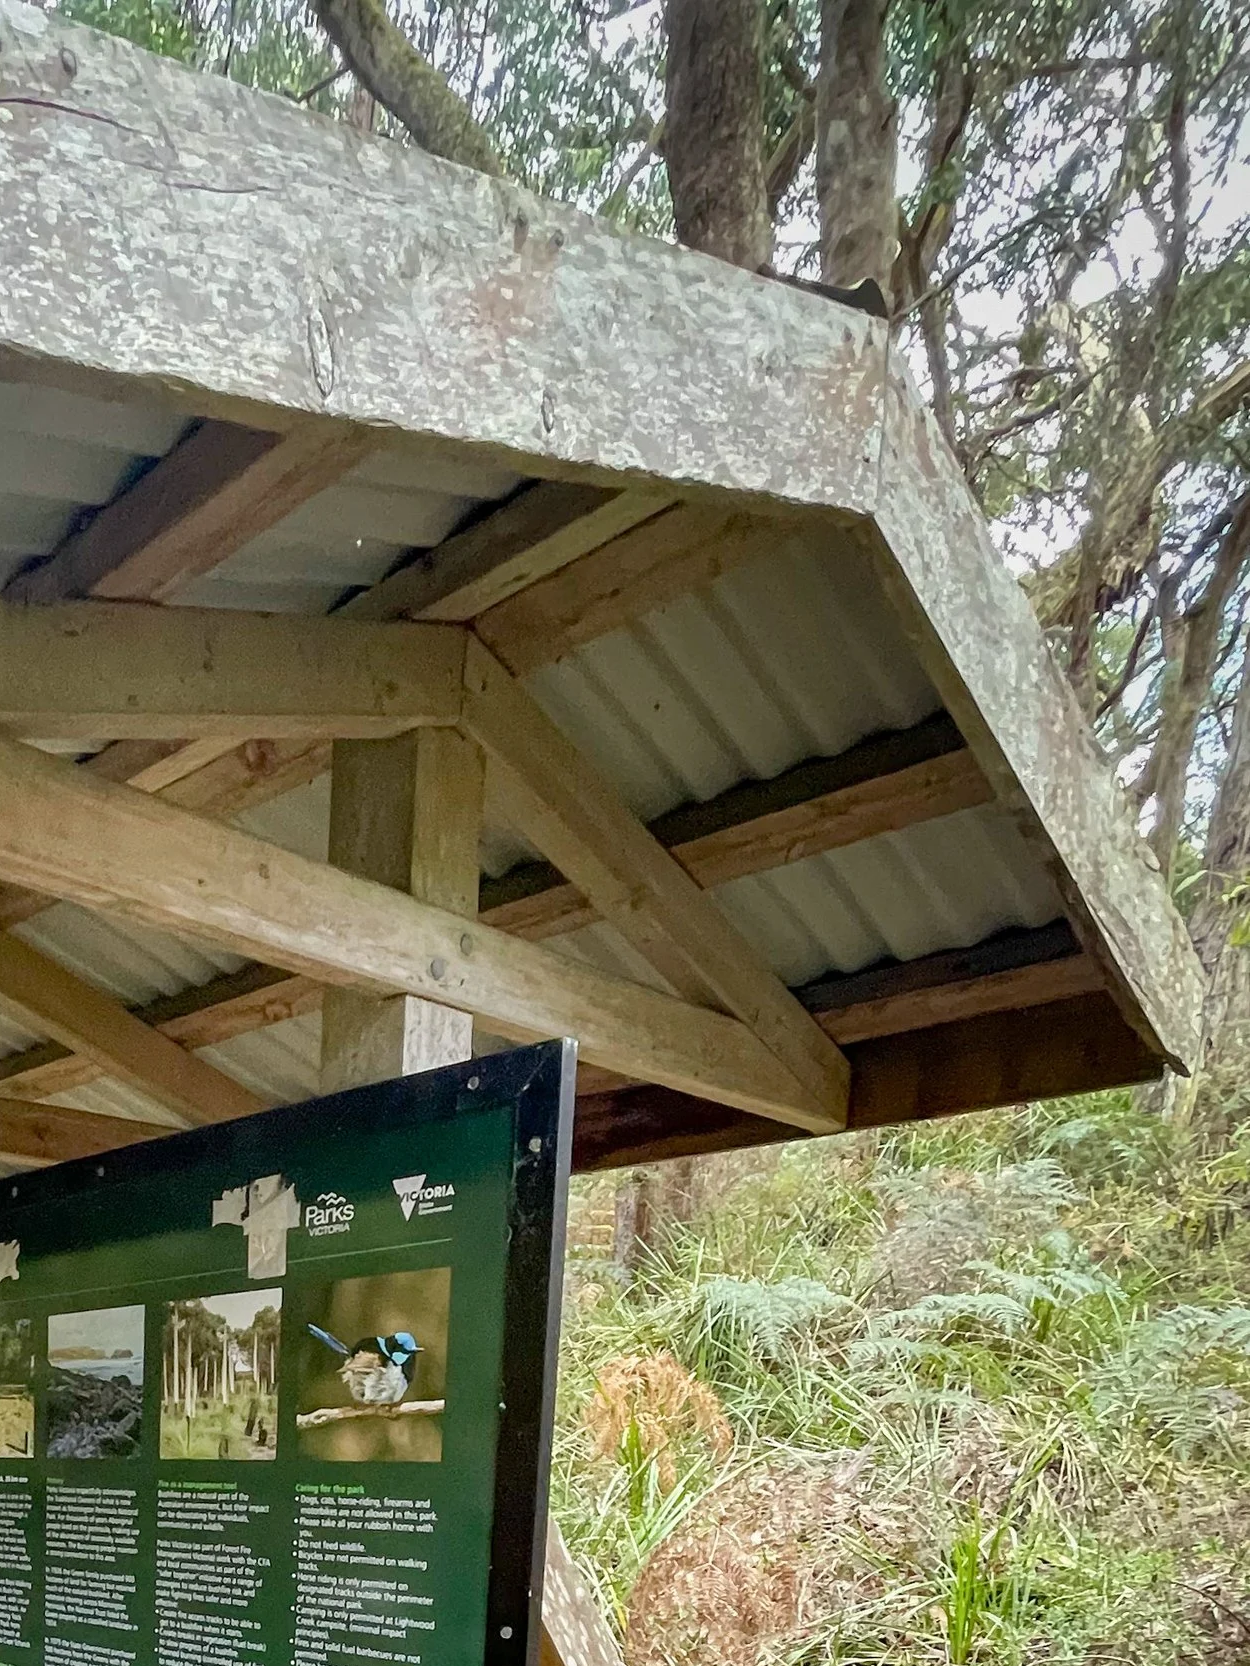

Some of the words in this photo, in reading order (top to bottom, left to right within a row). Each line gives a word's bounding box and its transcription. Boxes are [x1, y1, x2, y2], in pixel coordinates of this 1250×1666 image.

[400, 1184, 455, 1202] VICTORIA
[305, 1204, 354, 1228] Parks
[309, 1223, 350, 1237] VICTORIA
[296, 1484, 318, 1494] Caring
[320, 1484, 331, 1493] for
[333, 1484, 345, 1493] the
[347, 1485, 364, 1494] park
[384, 1497, 413, 1507] firearms
[415, 1499, 430, 1508] and
[365, 1510, 393, 1519] allowed
[404, 1511, 418, 1519] this
[300, 1517, 320, 1526] Please
[322, 1518, 336, 1527] take
[337, 1519, 345, 1528] all
[364, 1521, 391, 1529] rubbish
[393, 1522, 414, 1531] home
[416, 1524, 433, 1532] with
[300, 1539, 308, 1547] Do
[310, 1541, 321, 1549] not
[323, 1541, 338, 1549] feed
[298, 1551, 323, 1560] Bicycles
[337, 1554, 348, 1562] not
[350, 1556, 384, 1565] permitted
[398, 1558, 427, 1571] walking
[298, 1573, 315, 1582] Horse
[318, 1575, 337, 1586] riding
[345, 1578, 360, 1587] only
[362, 1580, 396, 1590] permitted
[298, 1585, 333, 1595] designated
[335, 1586, 354, 1597] tracks
[356, 1590, 382, 1599] outside
[384, 1592, 395, 1601] the
[297, 1595, 304, 1603] of
[306, 1596, 316, 1605] the
[318, 1598, 345, 1608] national
[296, 1605, 325, 1618] Camping
[334, 1611, 348, 1620] only
[350, 1613, 384, 1624] permitted
[386, 1617, 393, 1625] at
[395, 1617, 435, 1630] Lightwood
[295, 1638, 309, 1647] Fires
[311, 1641, 323, 1649] and
[325, 1642, 340, 1652] solid
[342, 1644, 355, 1654] fuel
[408, 1655, 420, 1664] not
